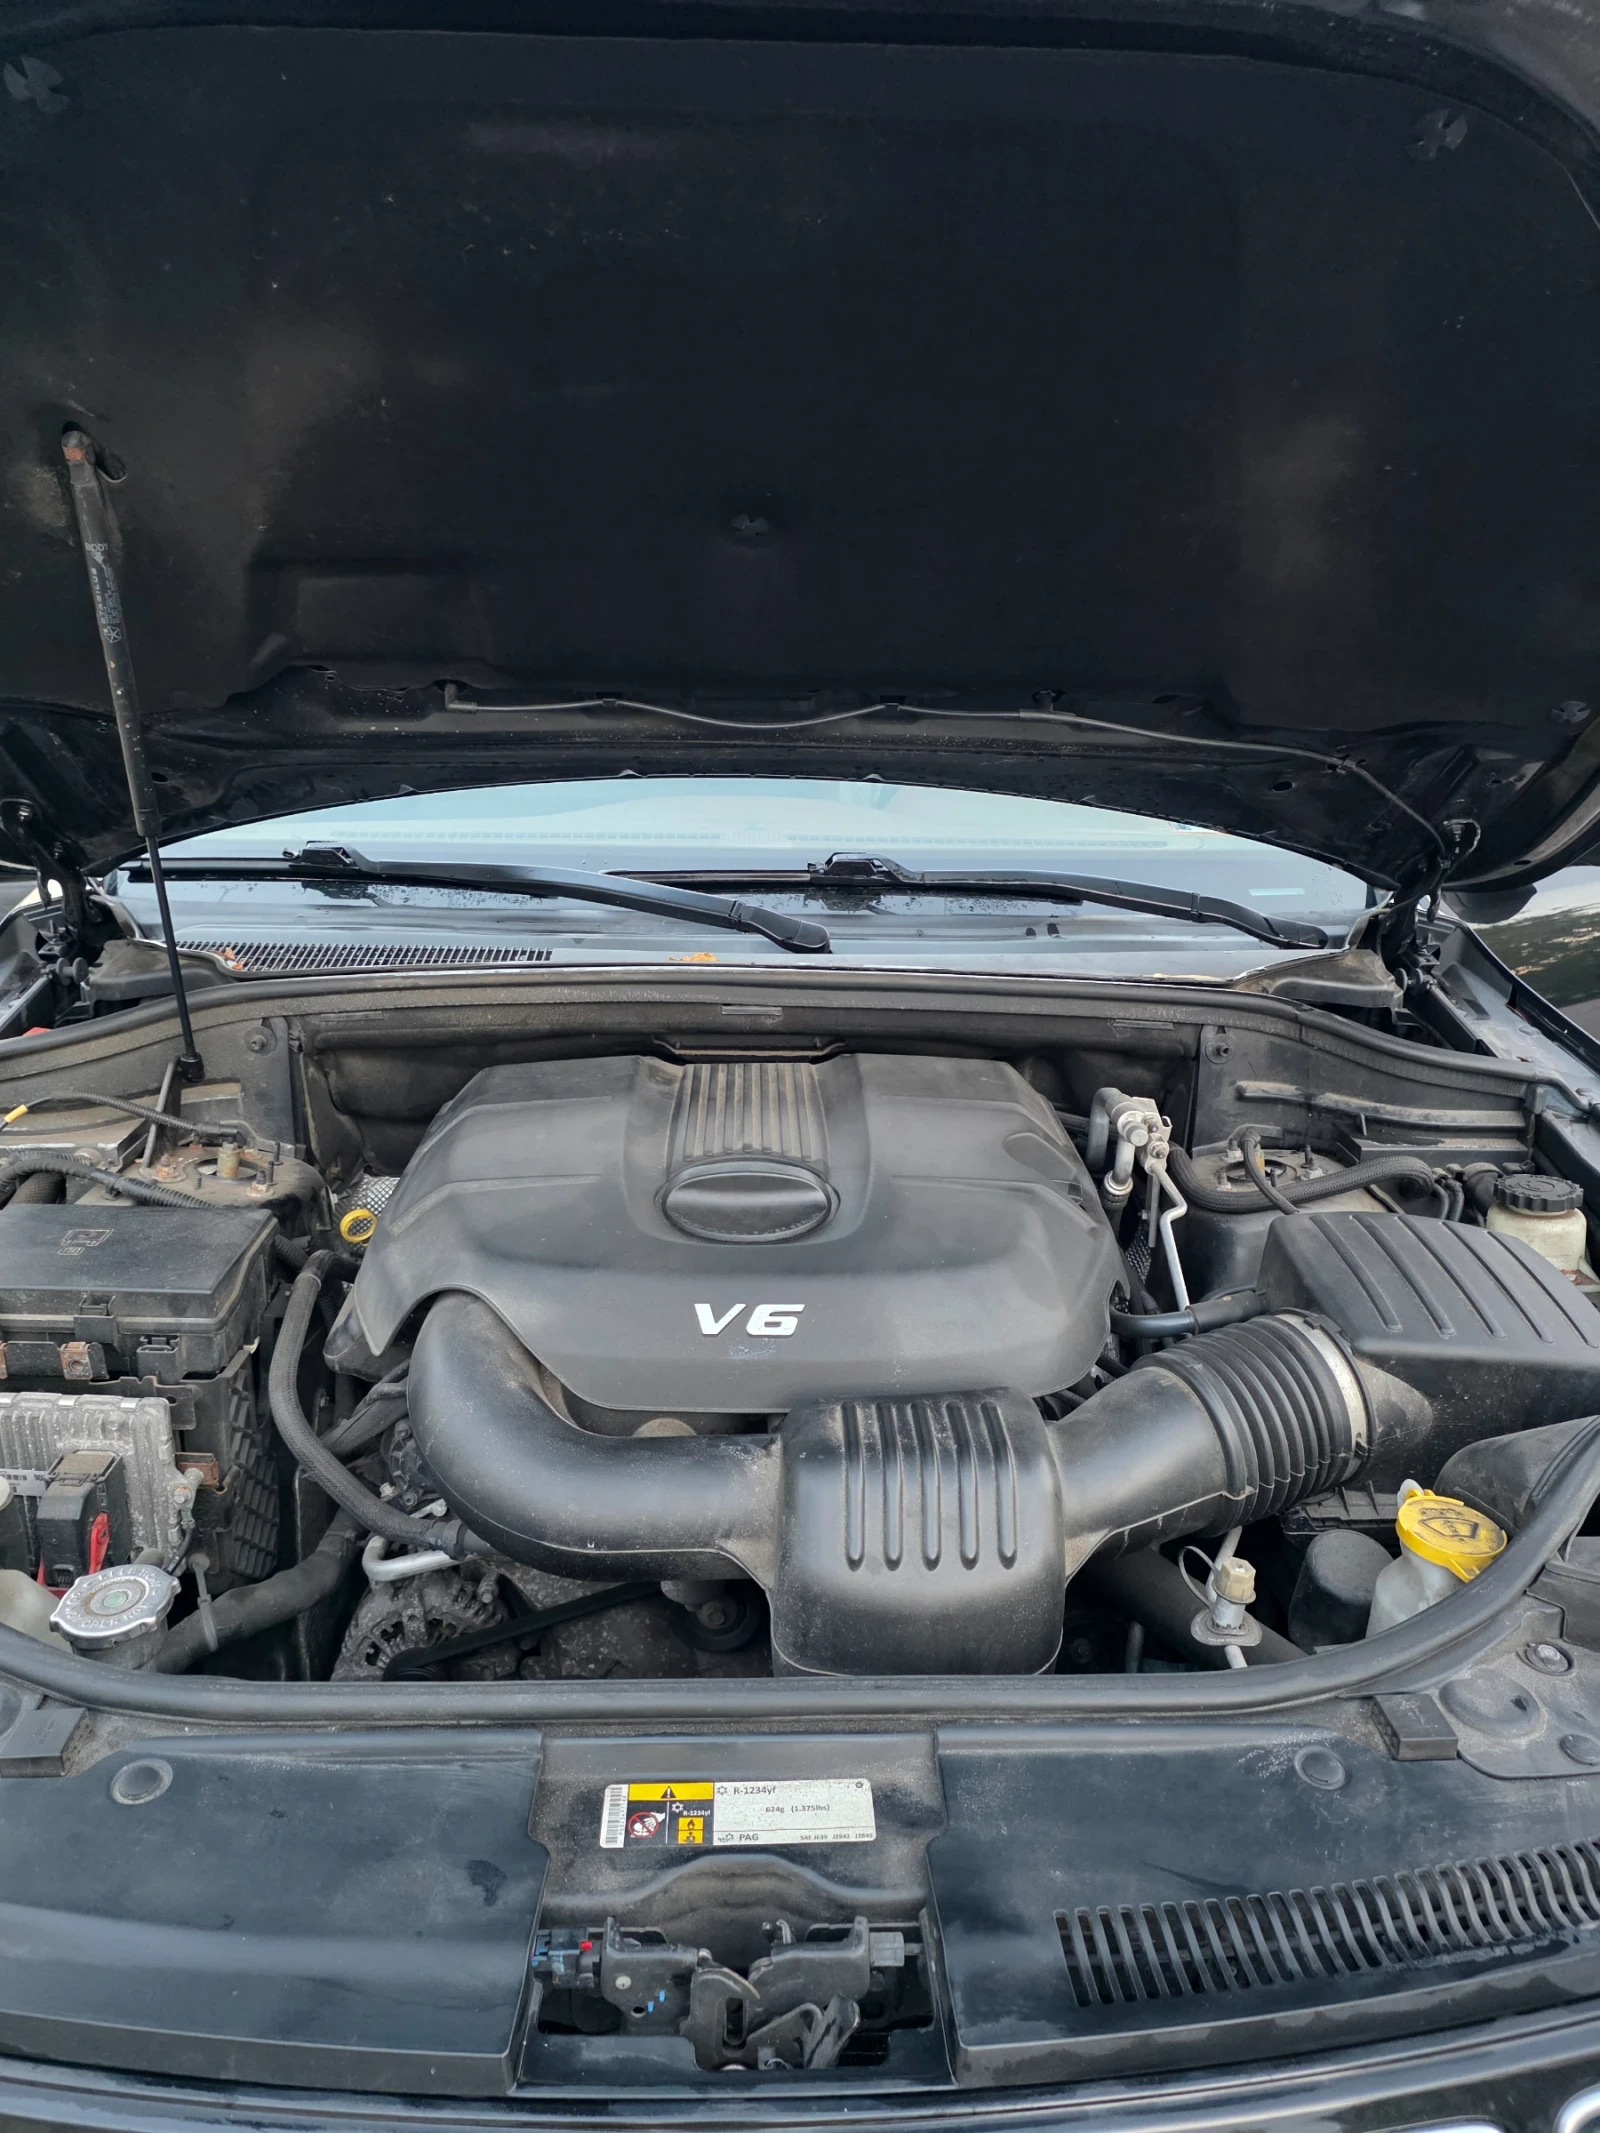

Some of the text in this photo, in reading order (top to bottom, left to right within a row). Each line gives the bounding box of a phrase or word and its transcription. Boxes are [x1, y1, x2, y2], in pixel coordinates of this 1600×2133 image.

[84, 542, 108, 551] BODY
[91, 567, 106, 624] STABILUS
[694, 1303, 805, 1337] V6
[733, 1785, 777, 1796] R-1234yf
[682, 1809, 711, 1817] R-1234yf
[765, 1803, 831, 1814] 624g (1.375lbs)
[738, 1833, 759, 1842] PAG
